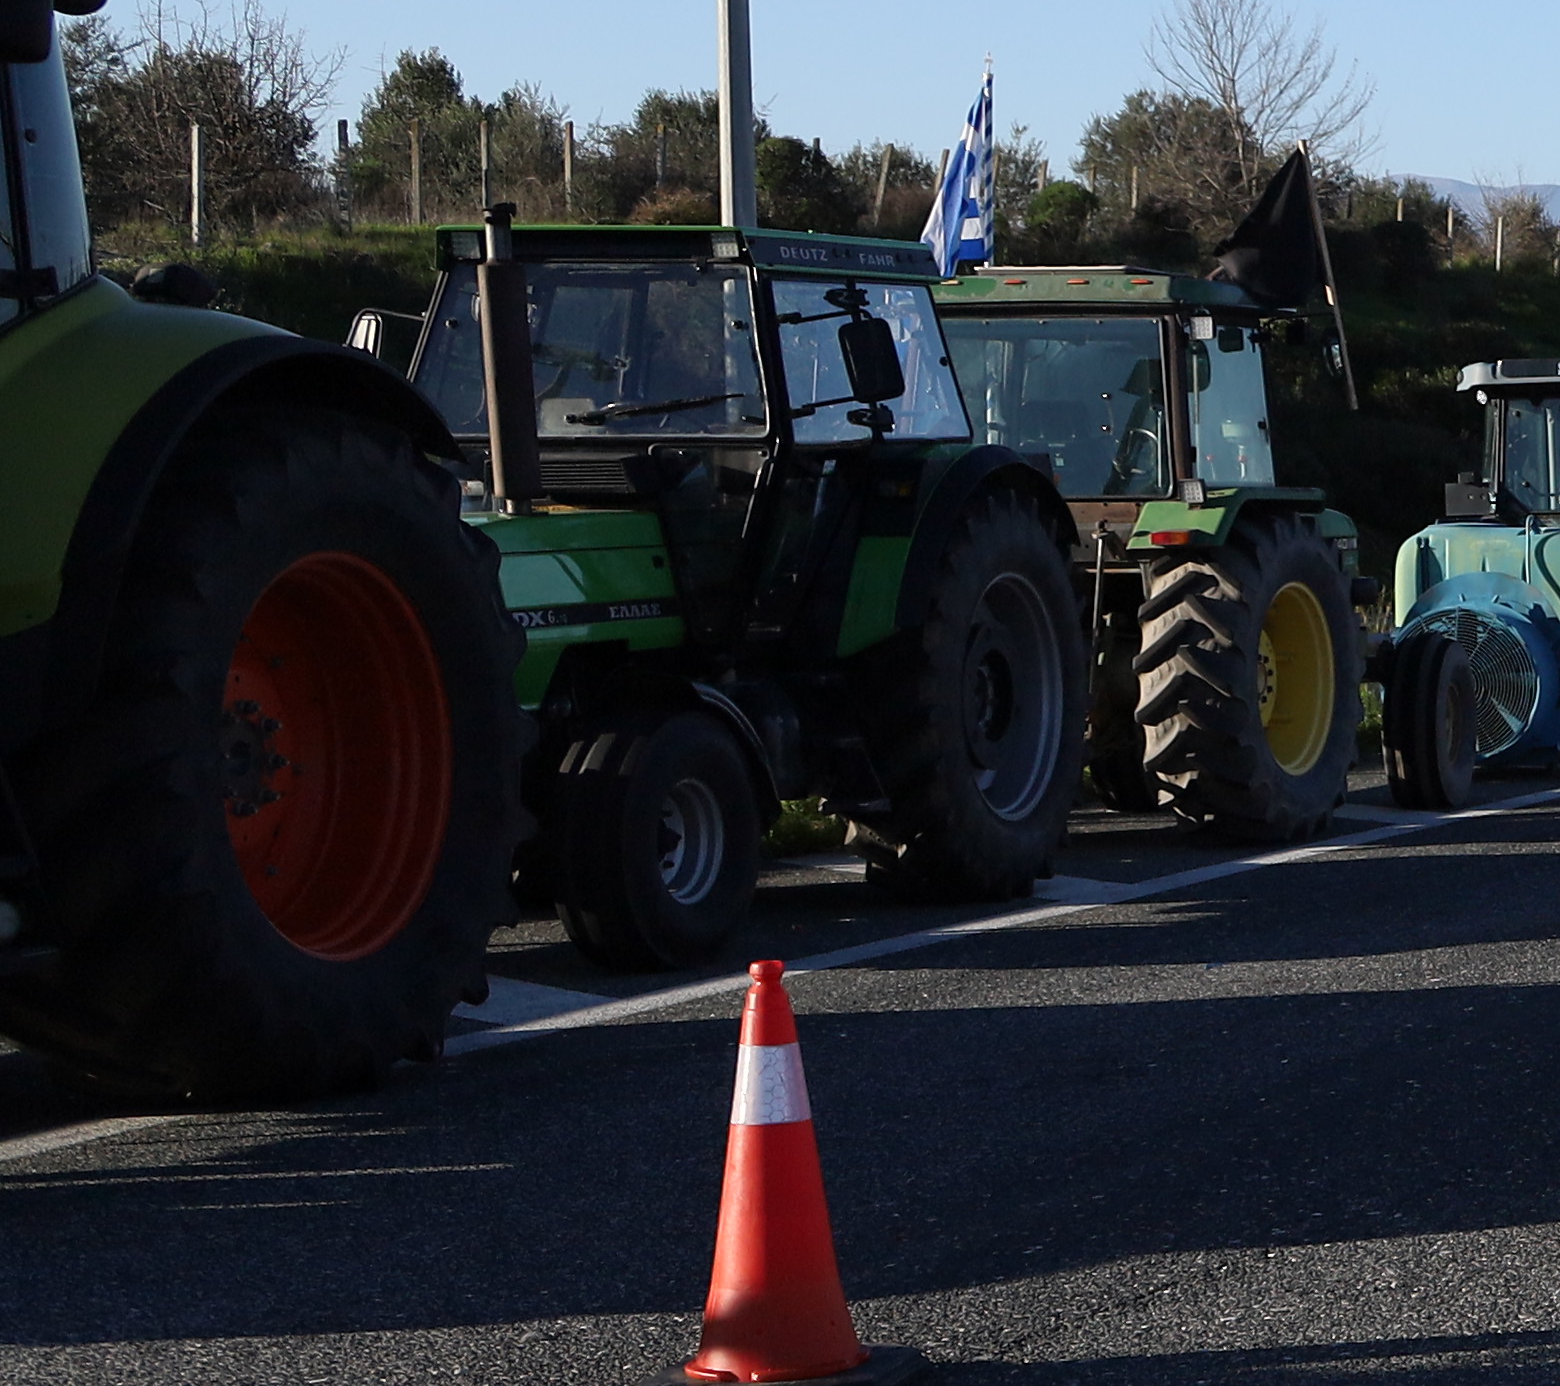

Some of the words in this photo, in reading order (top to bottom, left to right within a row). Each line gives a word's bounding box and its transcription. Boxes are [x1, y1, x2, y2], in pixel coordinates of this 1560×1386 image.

[779, 246, 828, 262] DEUTZ
[858, 252, 896, 267] FAHR
[512, 611, 546, 628] DX
